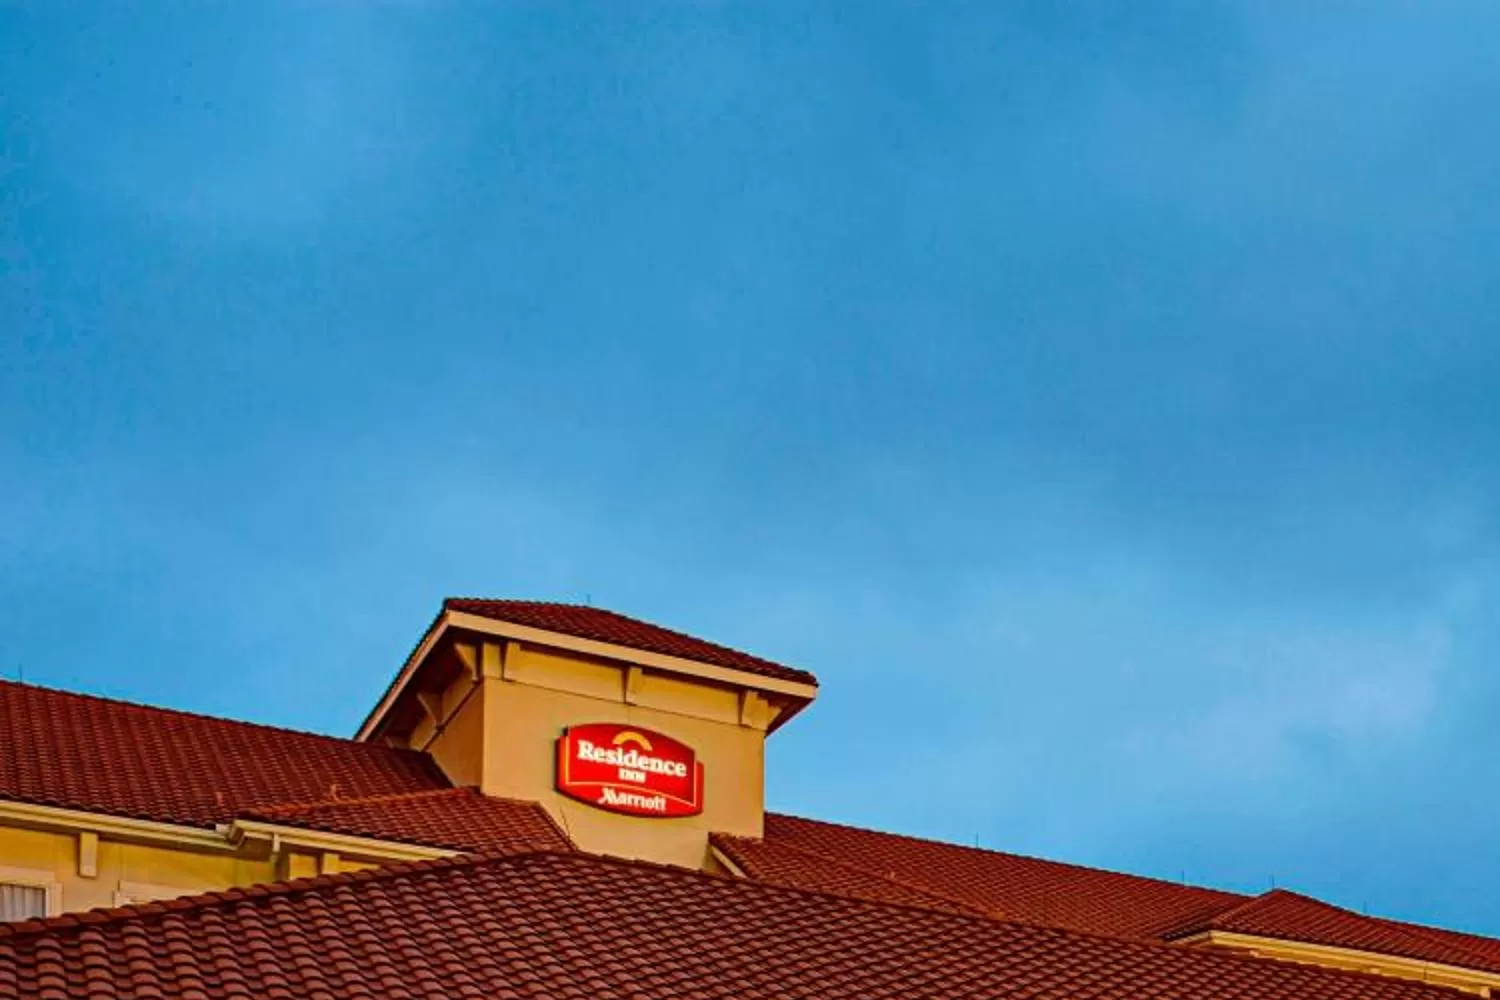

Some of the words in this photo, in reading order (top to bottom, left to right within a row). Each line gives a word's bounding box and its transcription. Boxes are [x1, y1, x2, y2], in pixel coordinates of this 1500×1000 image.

[577, 740, 687, 777] Residence
[618, 768, 646, 783] INN
[598, 787, 666, 811] Marriott
